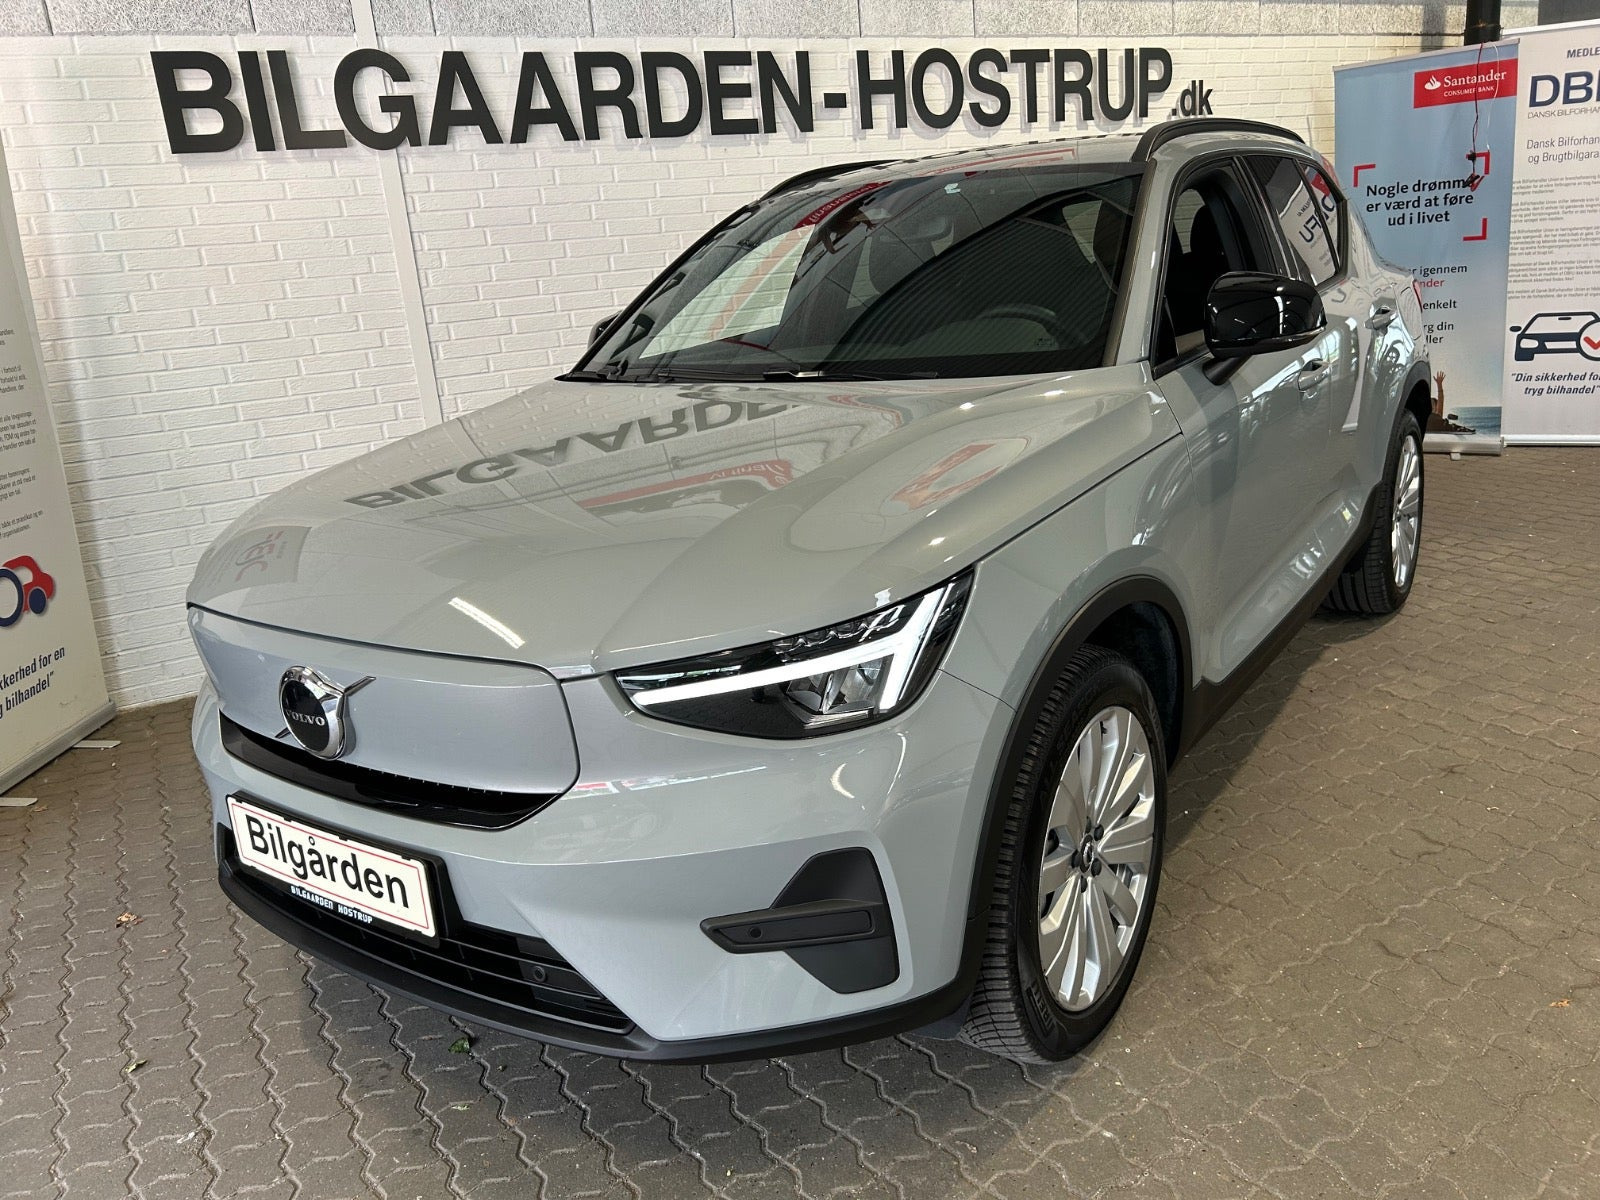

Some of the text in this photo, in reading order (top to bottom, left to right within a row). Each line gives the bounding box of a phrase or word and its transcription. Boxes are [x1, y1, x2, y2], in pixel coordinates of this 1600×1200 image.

[1443, 69, 1507, 88] Santander
[1529, 70, 1600, 108] DB
[1527, 107, 1600, 119] DANSK BILFORHA
[1527, 138, 1555, 149] Dansk
[1528, 154, 1539, 164] og
[1366, 178, 1474, 198] Nogle drømm
[1366, 193, 1474, 212] er værd at føre
[1388, 210, 1451, 226] ud i livet
[1420, 265, 1468, 278] igennem
[1420, 279, 1445, 288] nder
[1423, 299, 1457, 310] enkelt
[1423, 322, 1454, 334] rg din
[1426, 334, 1444, 344] ller
[1535, 372, 1587, 382] sikkerhed
[1524, 387, 1544, 396] tryg
[39, 654, 52, 669] for
[54, 647, 65, 661] en
[285, 709, 326, 726] VOLVO
[245, 814, 410, 909] Bilgården
[291, 885, 373, 924] BILGAARDEN HOSTRUP
